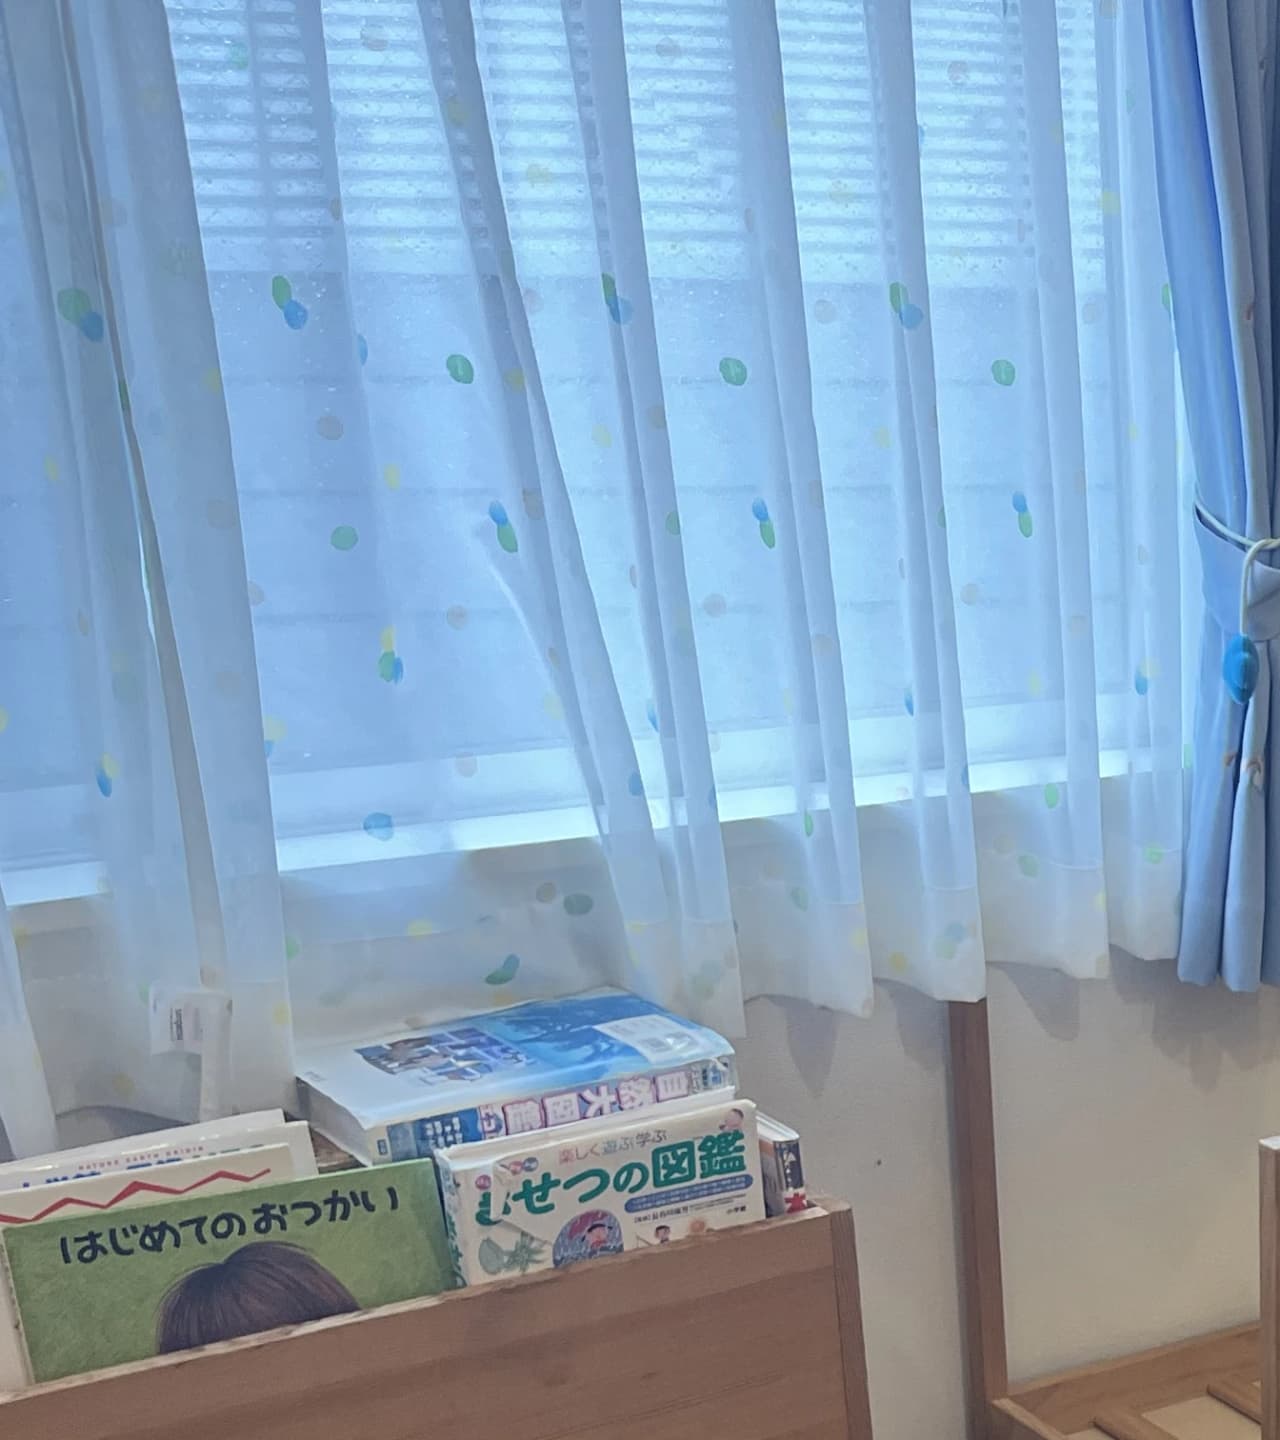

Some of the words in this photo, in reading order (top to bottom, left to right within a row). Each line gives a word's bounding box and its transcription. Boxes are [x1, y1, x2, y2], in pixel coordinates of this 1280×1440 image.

[126, 1153, 160, 1164] EARTH
[60, 1186, 399, 1265] はじめてのおつかい
